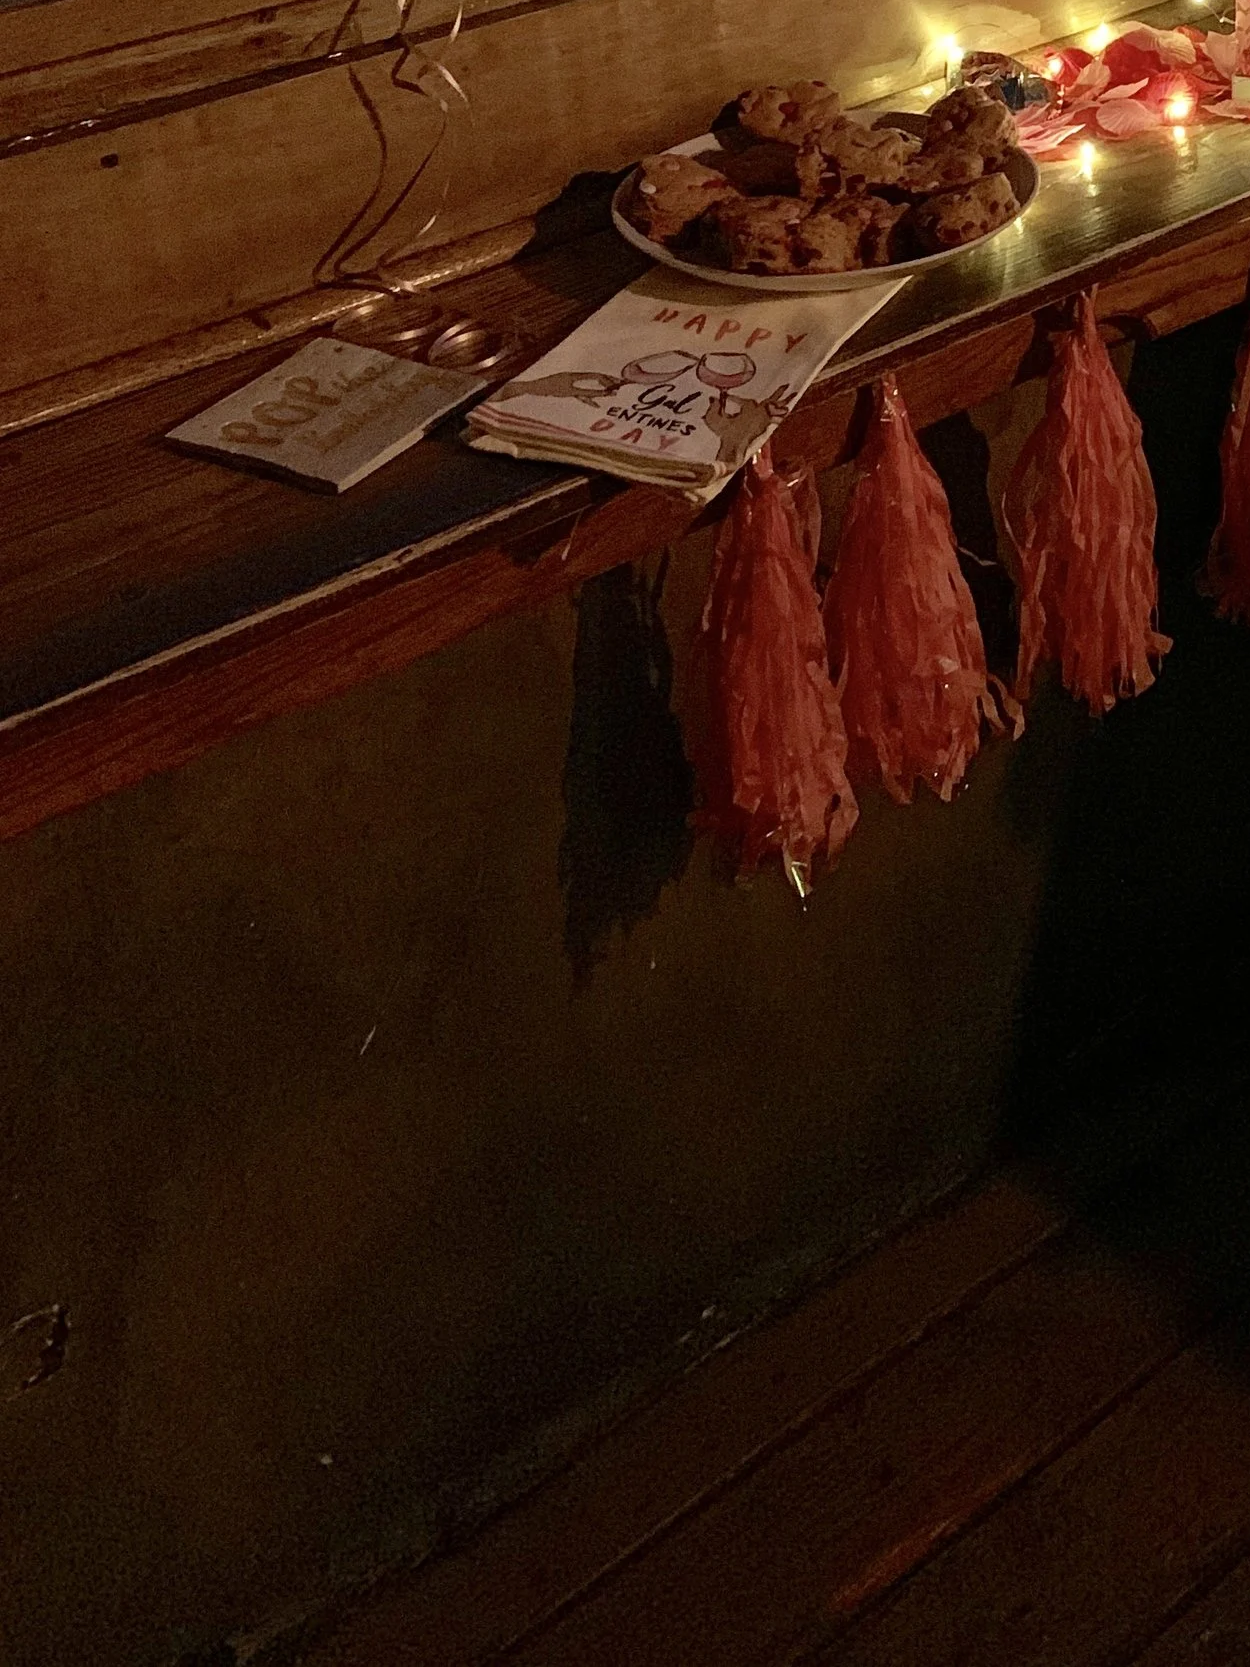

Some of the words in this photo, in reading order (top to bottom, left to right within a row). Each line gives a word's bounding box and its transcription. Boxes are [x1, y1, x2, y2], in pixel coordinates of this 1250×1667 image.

[652, 307, 809, 354] HAPPY
[631, 384, 704, 415] Gal
[589, 417, 682, 451] DAY
[606, 406, 697, 437] ENTINES
